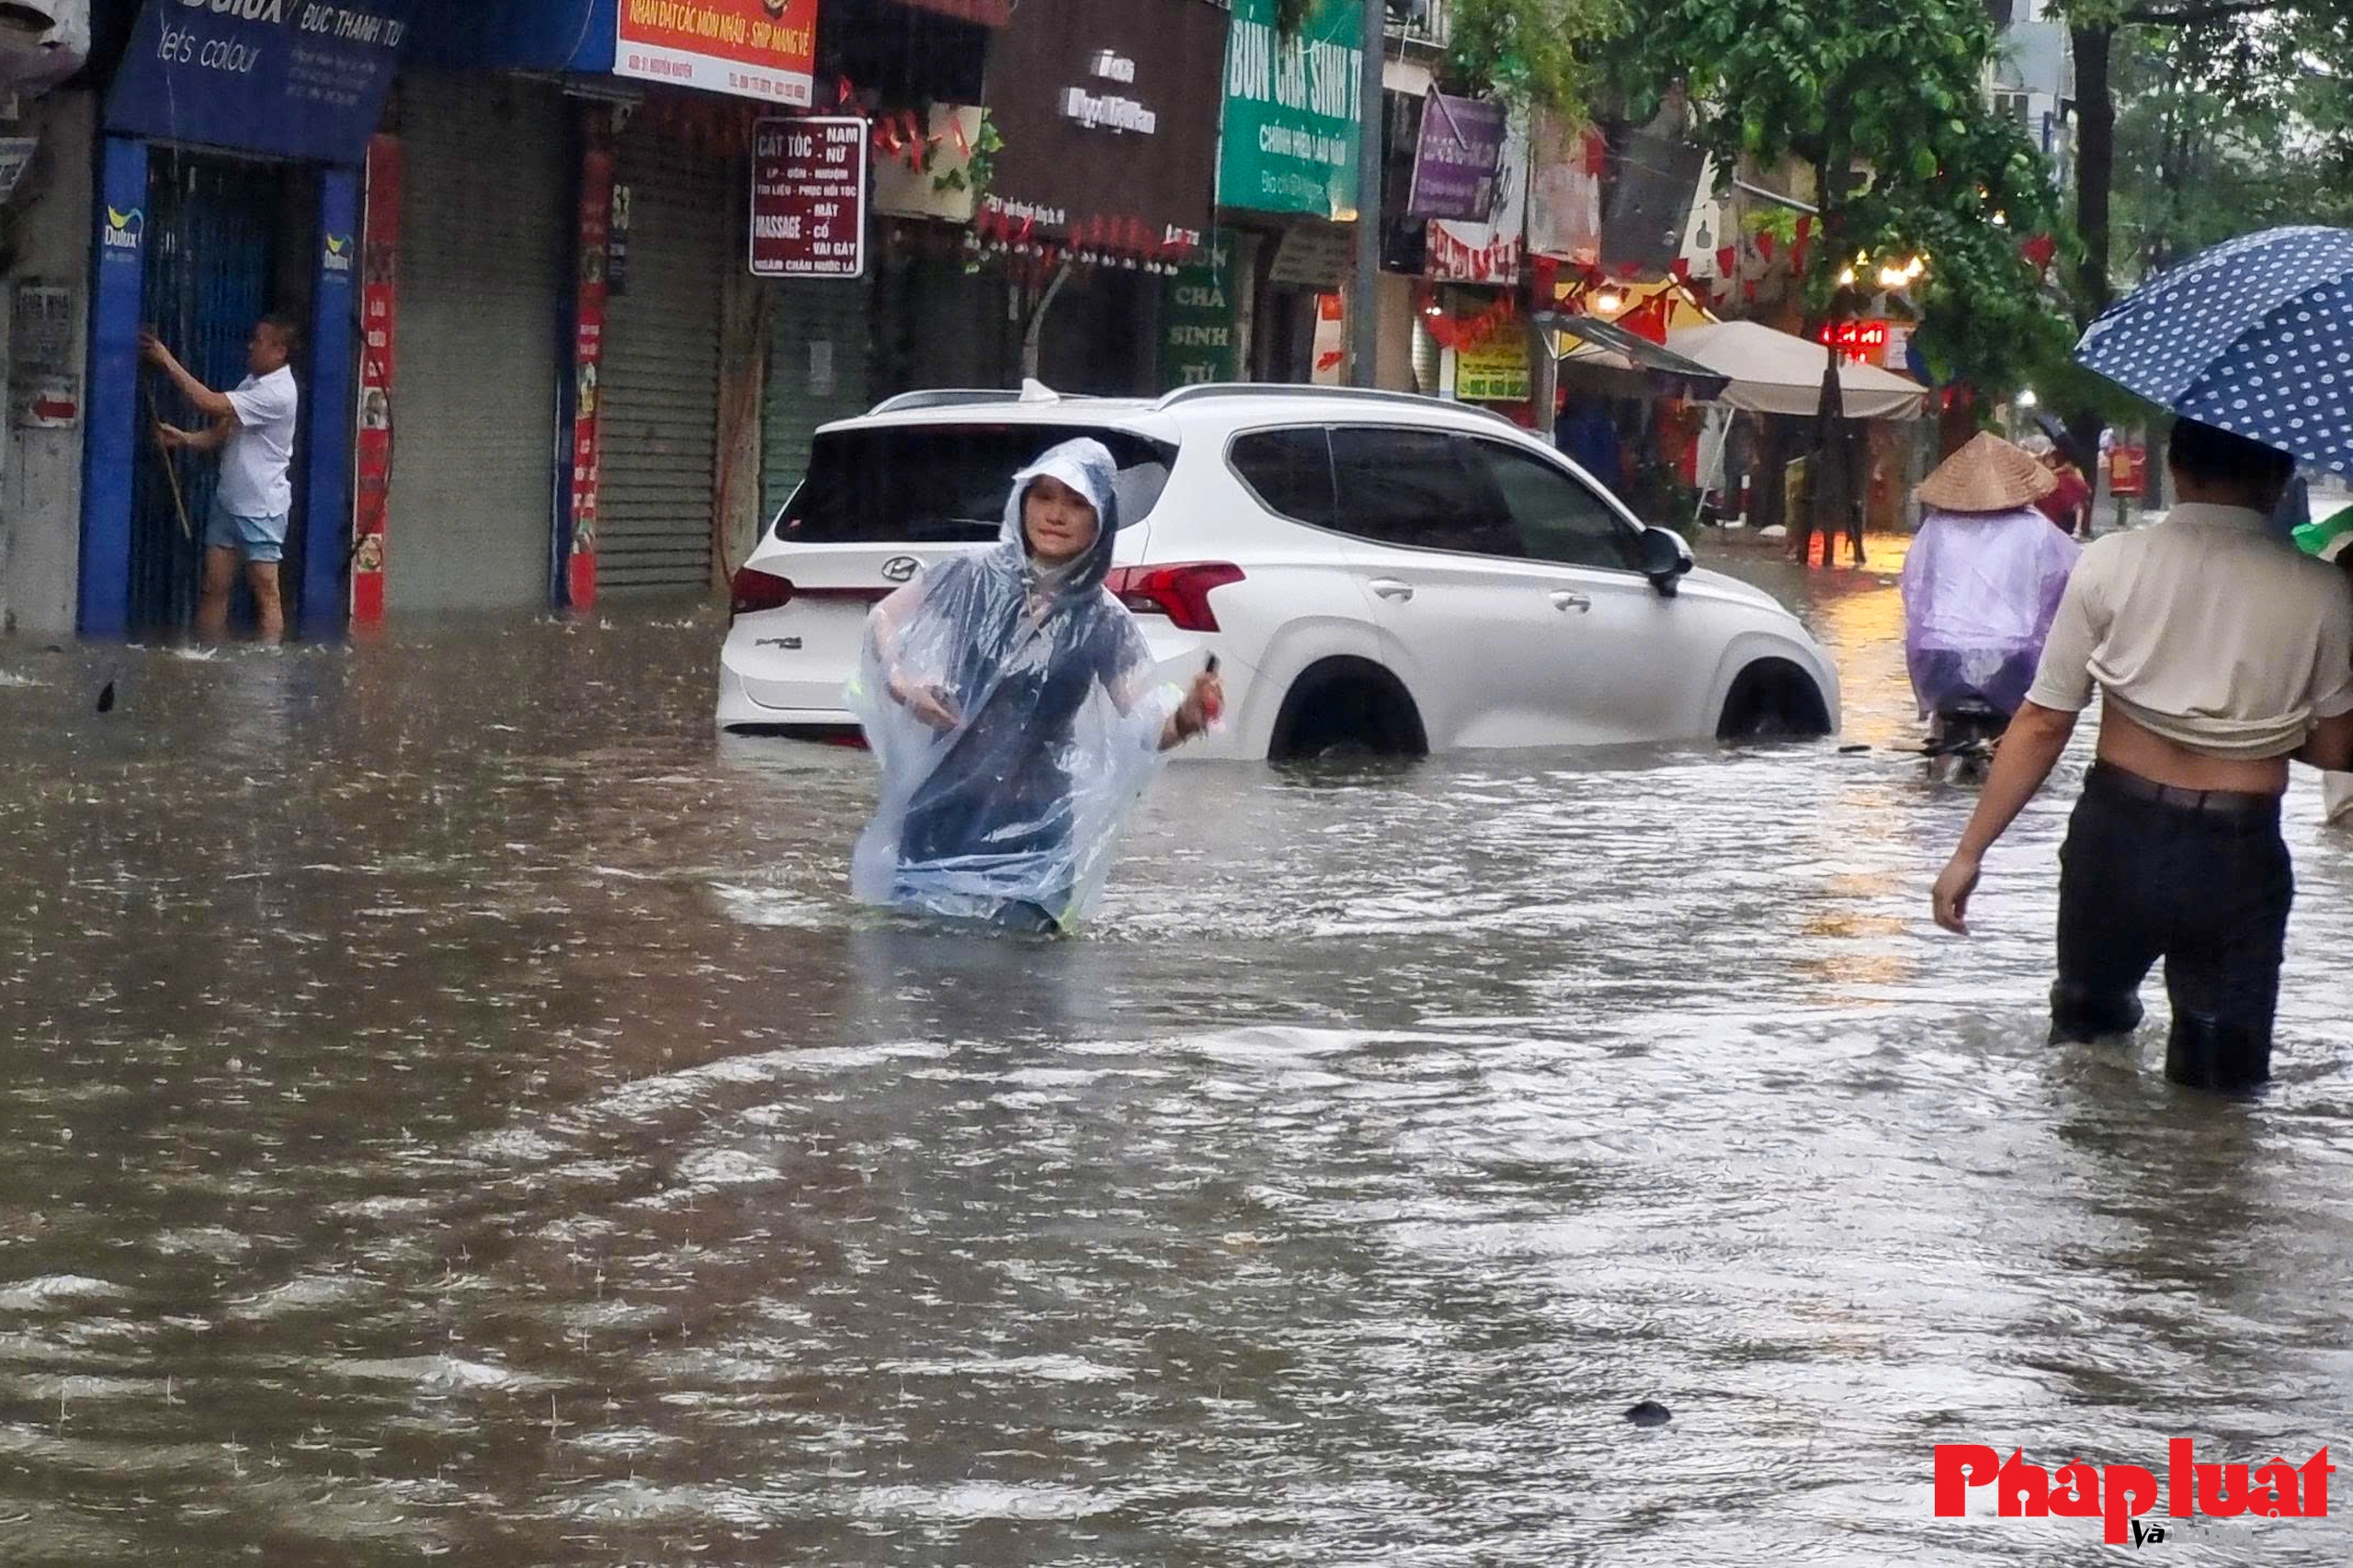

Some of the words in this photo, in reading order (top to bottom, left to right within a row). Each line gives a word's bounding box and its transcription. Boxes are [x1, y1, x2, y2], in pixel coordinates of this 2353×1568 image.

[1230, 4, 1270, 102] BÚN
[1310, 40, 1347, 119] SINH
[788, 131, 813, 157] TÓC
[826, 127, 858, 143] NAM
[104, 224, 137, 249] Dulux
[756, 215, 801, 239] MASSAGE
[813, 241, 831, 256] VAI
[1169, 325, 1229, 347] SINH
